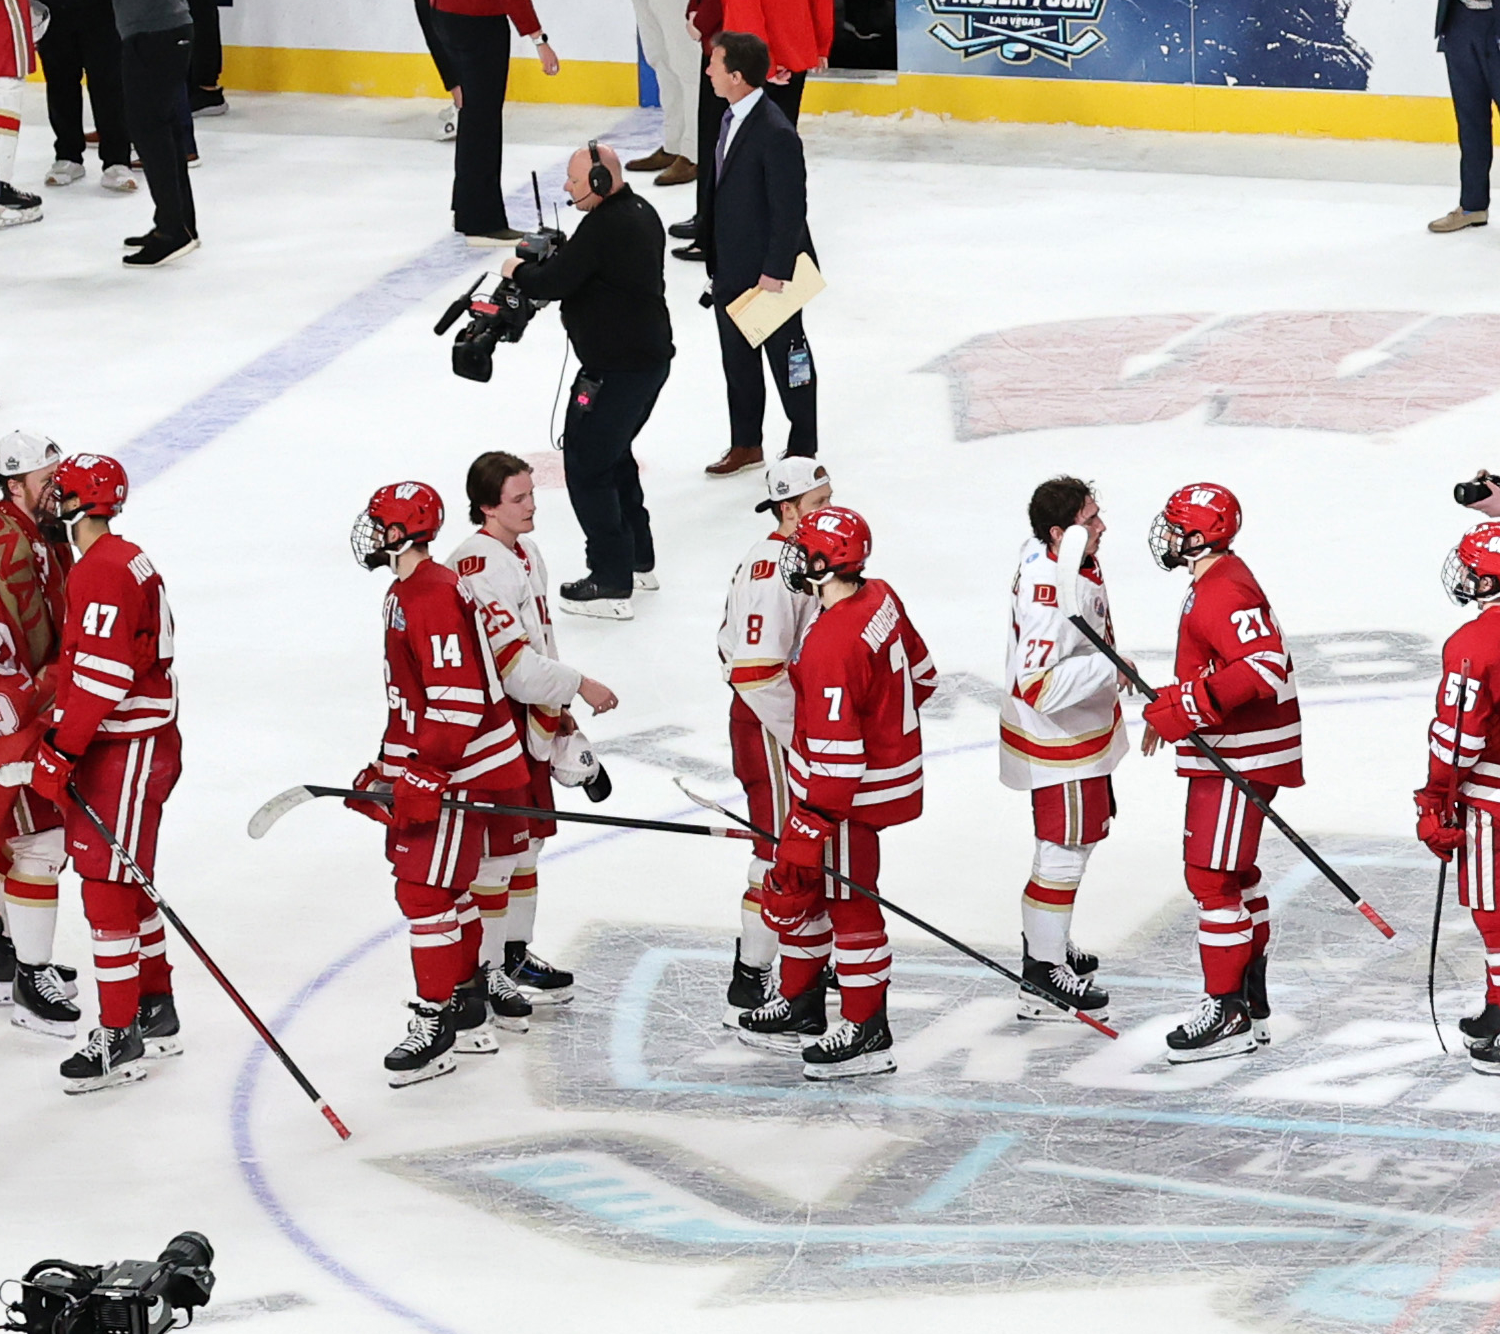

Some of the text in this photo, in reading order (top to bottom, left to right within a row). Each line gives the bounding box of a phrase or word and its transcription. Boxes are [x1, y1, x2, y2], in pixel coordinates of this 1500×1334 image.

[988, 15, 1042, 27] LAS VEGAS
[394, 483, 419, 501] W
[1190, 489, 1215, 507] W
[816, 514, 842, 534] W
[83, 602, 118, 639] 47
[746, 613, 764, 645] 8
[1230, 607, 1271, 644] 27
[430, 633, 461, 669] 14
[1024, 639, 1055, 669] 27
[823, 687, 843, 721] 7
[1443, 670, 1481, 713] 55
[1235, 1149, 1464, 1192] LAS
